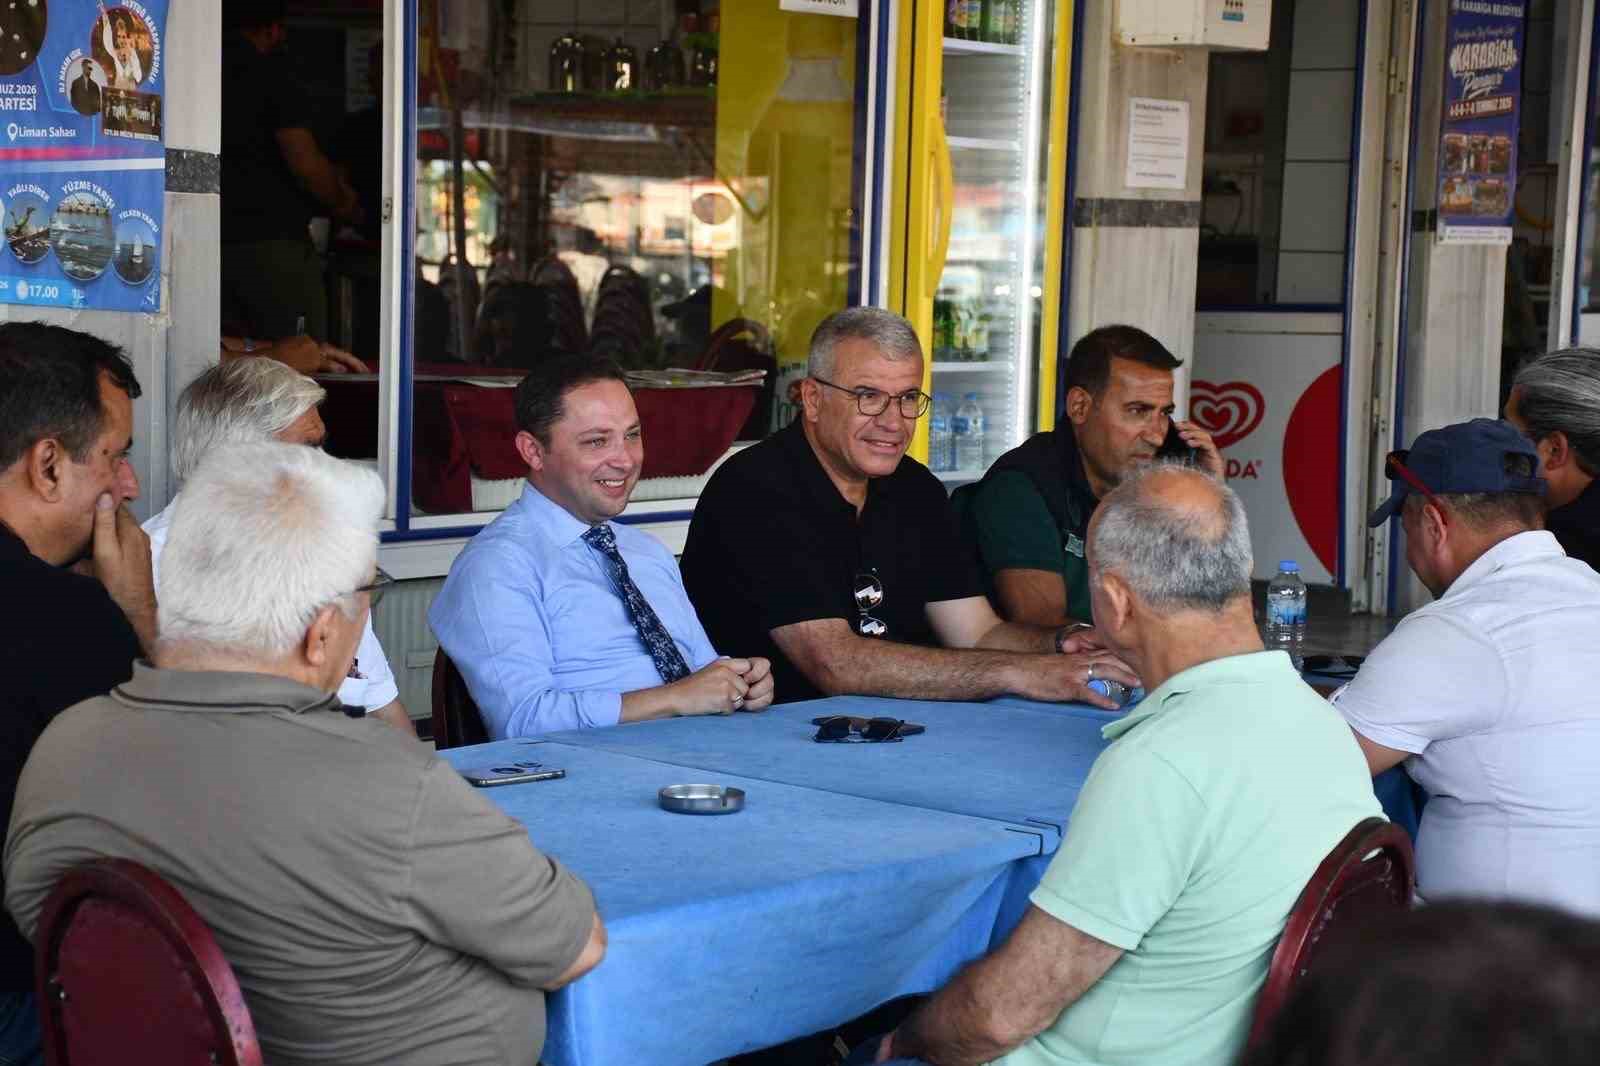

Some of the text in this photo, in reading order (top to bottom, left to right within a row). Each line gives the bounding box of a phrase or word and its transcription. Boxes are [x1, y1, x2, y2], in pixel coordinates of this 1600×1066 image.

[1456, 39, 1513, 71] KARABİGA
[0, 84, 37, 95] UZ 2026
[19, 126, 76, 137] Liman Sahası
[61, 180, 92, 195] YÜZME
[30, 285, 59, 298] 17.00
